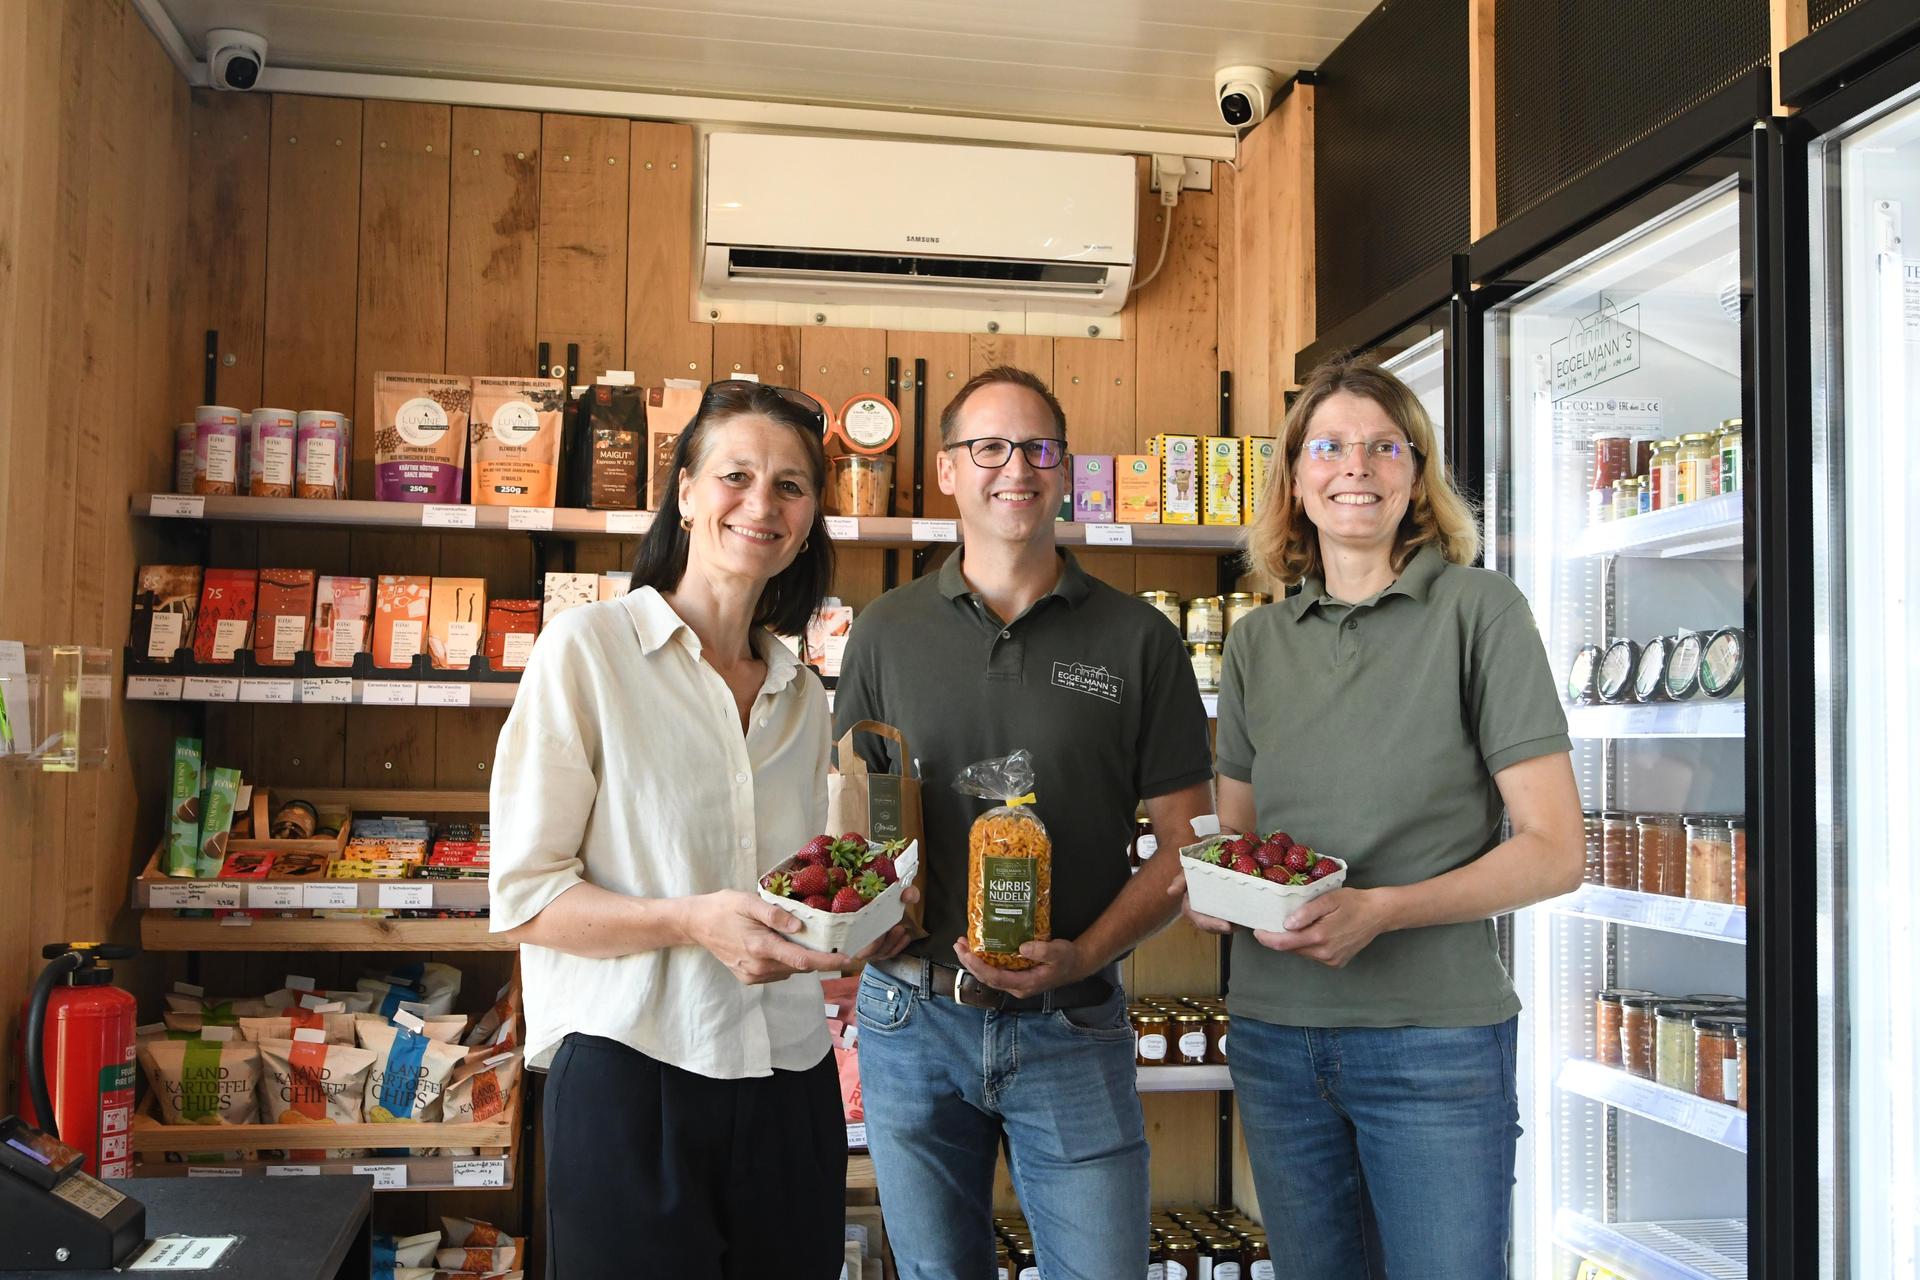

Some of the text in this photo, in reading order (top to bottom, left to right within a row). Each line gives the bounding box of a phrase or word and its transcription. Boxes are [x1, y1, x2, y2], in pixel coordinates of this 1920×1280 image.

[906, 235, 940, 243] SAMSUNG
[410, 485, 428, 493] 250g
[500, 486, 522, 494] 250g
[143, 576, 160, 588] 85
[208, 588, 224, 599] 75
[989, 879, 1031, 892] KÜRBIS
[989, 890, 1031, 901] NUDELN
[185, 1067, 229, 1080] LAND
[389, 1061, 429, 1079] LAND
[165, 1080, 251, 1094] KARTOFFEL
[172, 1094, 231, 1112] CHIPS
[372, 1084, 427, 1110] CHIPS
